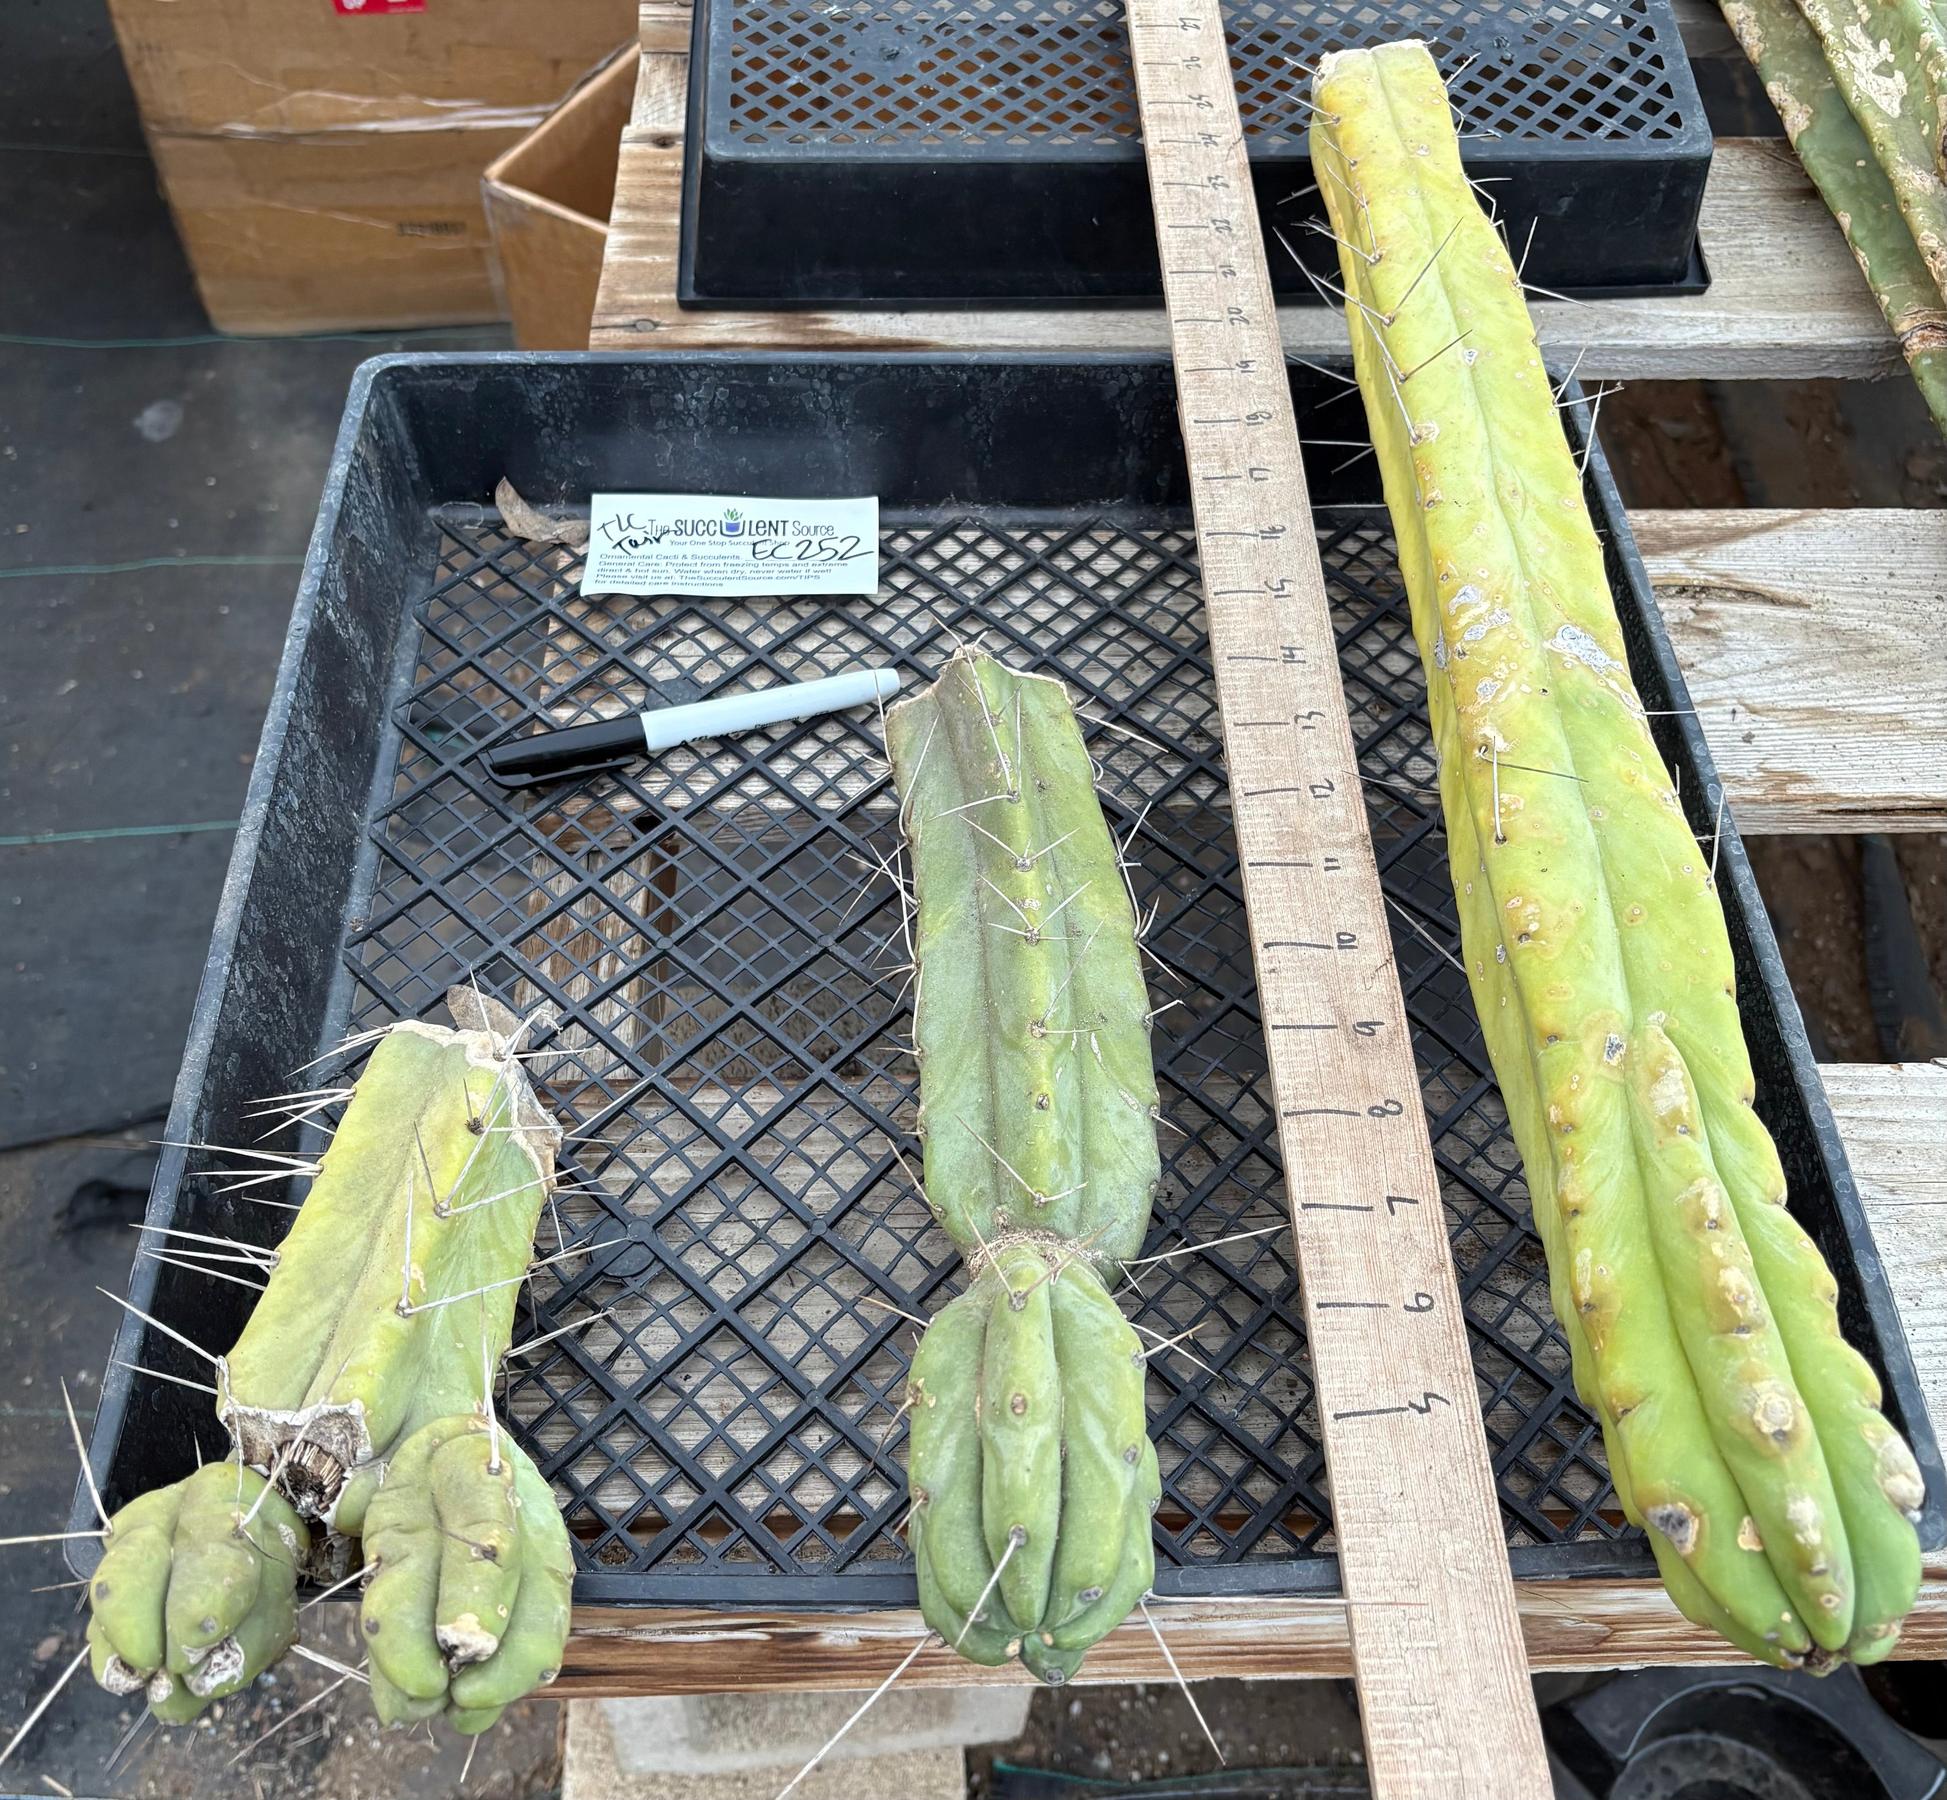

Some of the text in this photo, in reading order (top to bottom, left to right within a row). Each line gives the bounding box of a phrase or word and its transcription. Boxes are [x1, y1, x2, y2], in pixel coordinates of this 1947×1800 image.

[1178, 16, 1202, 31] 27
[1182, 56, 1202, 70] 26
[1188, 95, 1214, 109] 25
[1197, 132, 1221, 148] 24
[1207, 175, 1230, 190] 23
[1211, 218, 1233, 234] 22
[1219, 265, 1236, 278] 21
[1227, 307, 1250, 326] 20
[1236, 360, 1256, 373] 19
[1245, 411, 1273, 426] 18
[1248, 467, 1272, 481] 17
[792, 520, 835, 537] Source
[708, 539, 727, 547] Stop
[751, 535, 874, 562] EC252
[1264, 578, 1295, 599] 15
[1279, 645, 1307, 664] 14
[1293, 711, 1325, 730] 13
[1308, 778, 1336, 799] 12
[1335, 931, 1358, 950] 10
[1352, 1021, 1385, 1036] 9
[1366, 1099, 1404, 1118] 8
[1385, 1195, 1419, 1216] 7
[1403, 1291, 1435, 1313] 6
